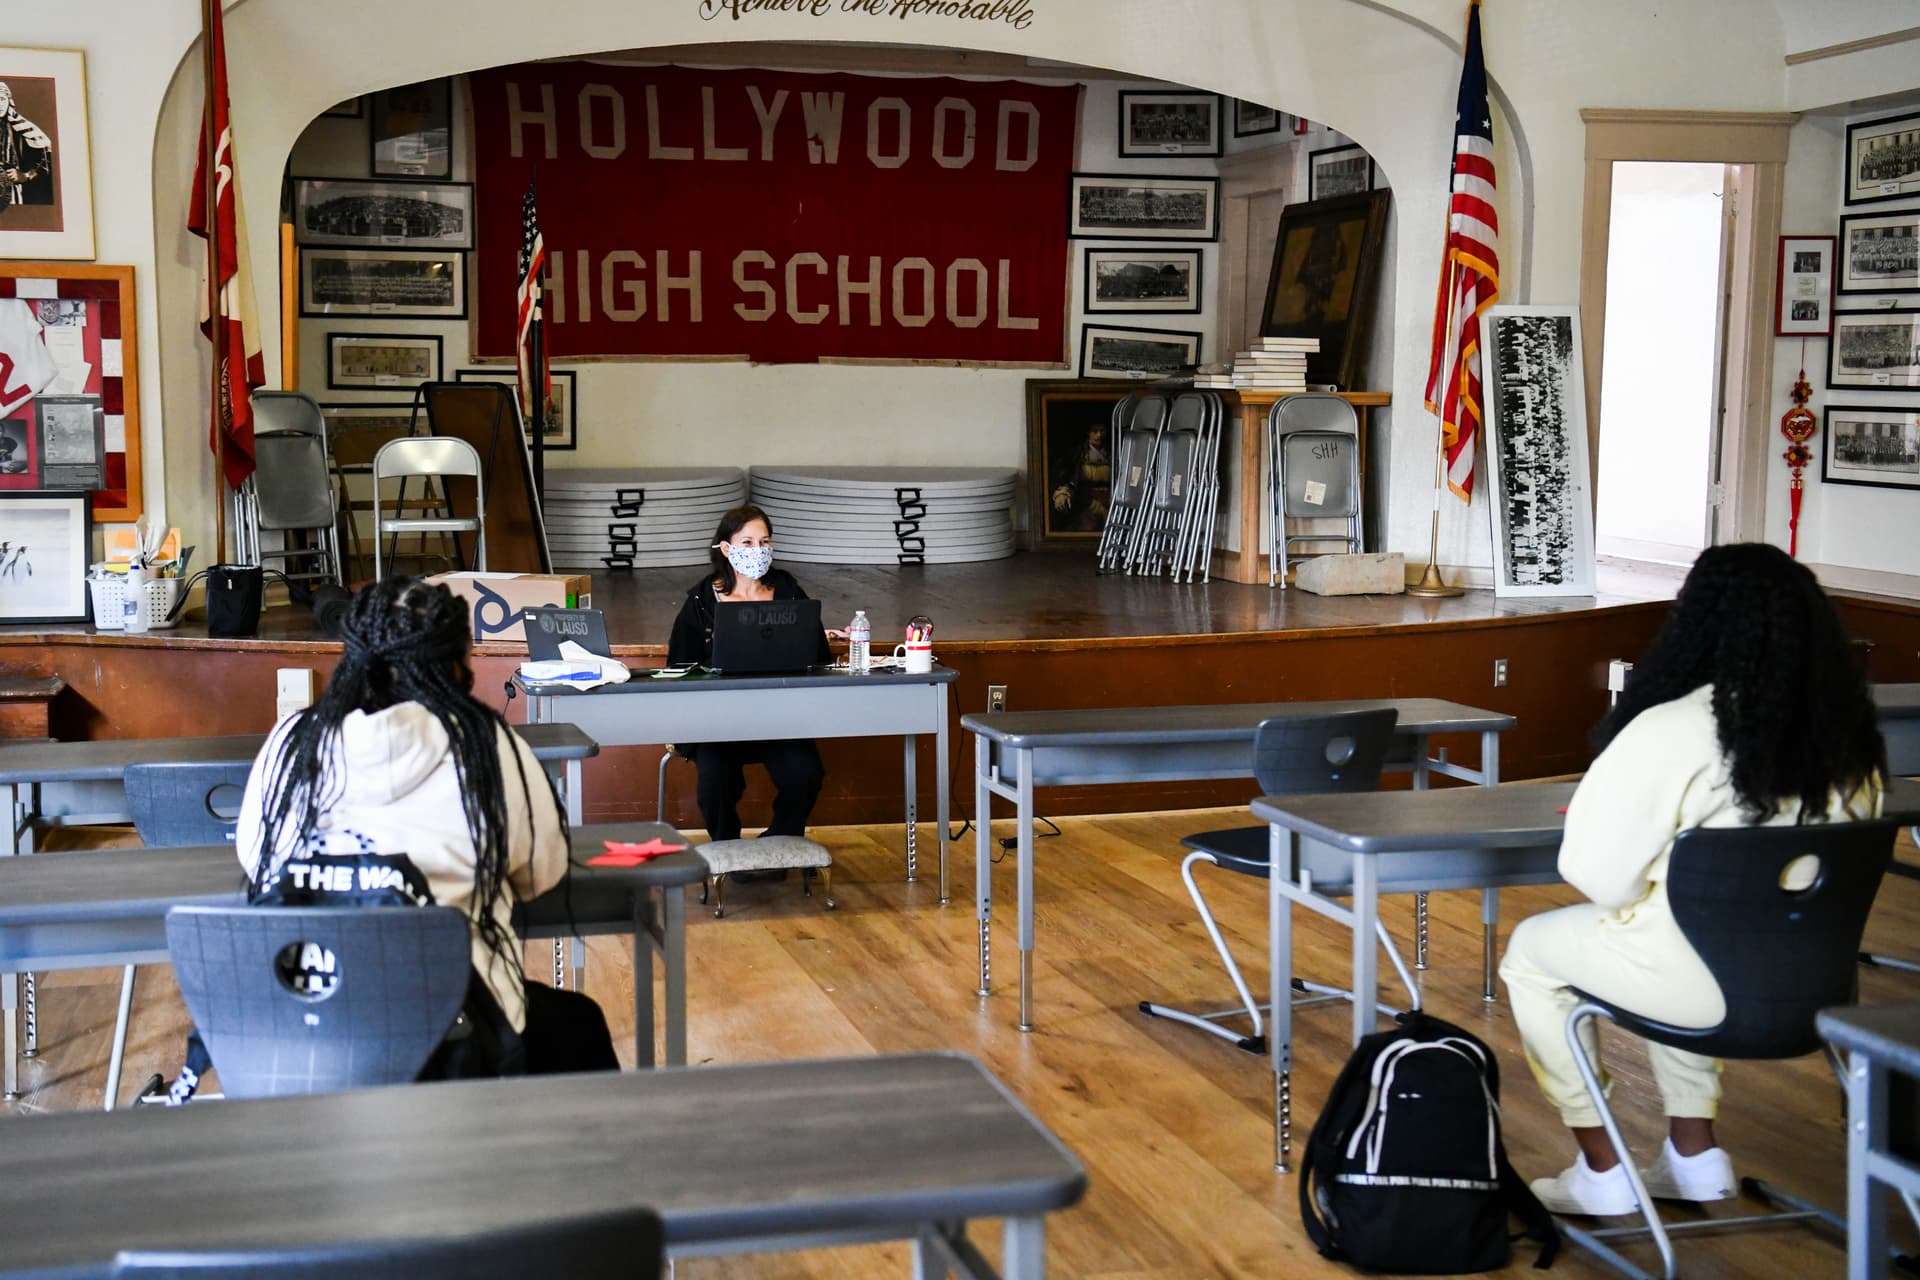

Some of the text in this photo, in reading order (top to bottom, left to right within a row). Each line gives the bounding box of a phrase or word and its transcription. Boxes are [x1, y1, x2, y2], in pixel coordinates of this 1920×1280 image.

[889, 0, 1034, 30] Honorable
[506, 82, 1041, 172] HOLLYWOOD
[517, 249, 1039, 329] HIGH SCHOOL
[1311, 441, 1338, 460] SHH
[555, 620, 589, 636] LAUSD
[758, 611, 797, 625] LAUSD
[288, 864, 412, 892] THE WA
